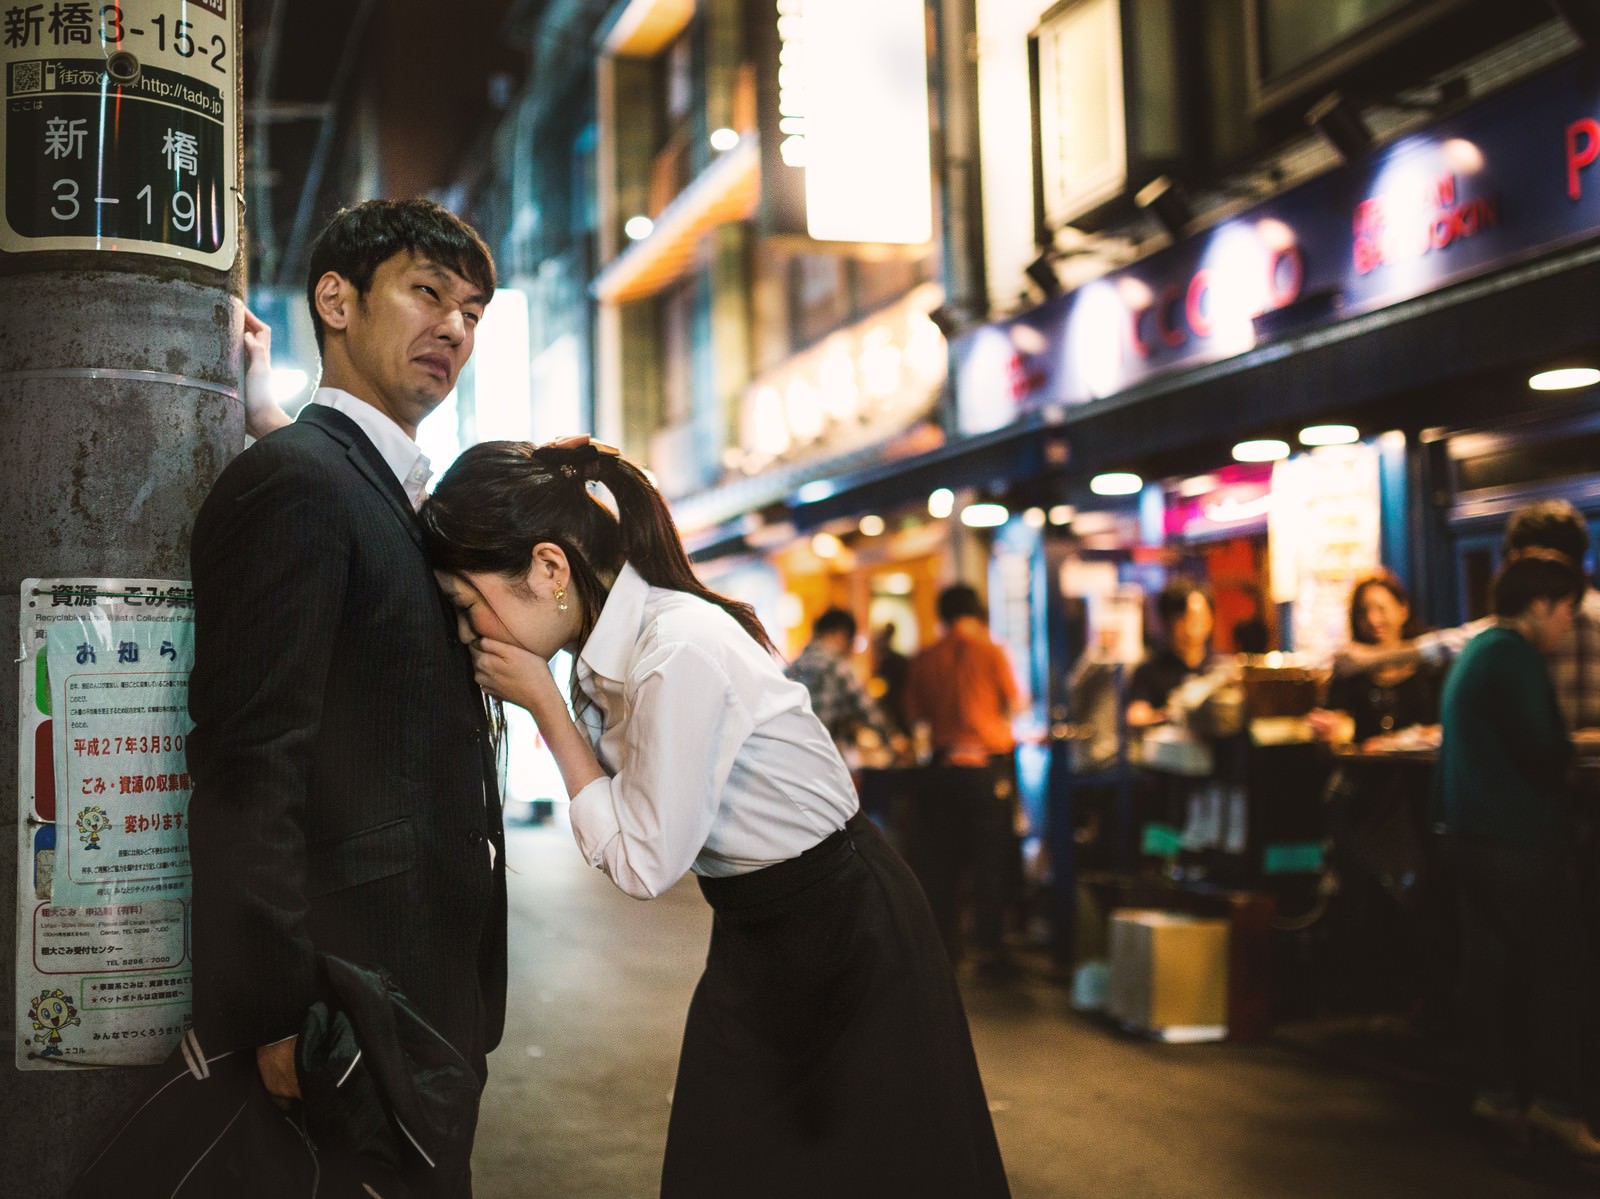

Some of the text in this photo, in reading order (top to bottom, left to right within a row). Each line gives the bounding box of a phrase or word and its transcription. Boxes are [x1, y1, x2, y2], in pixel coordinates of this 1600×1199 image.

[81, 774, 192, 796] ごみ・資源の収集曜
